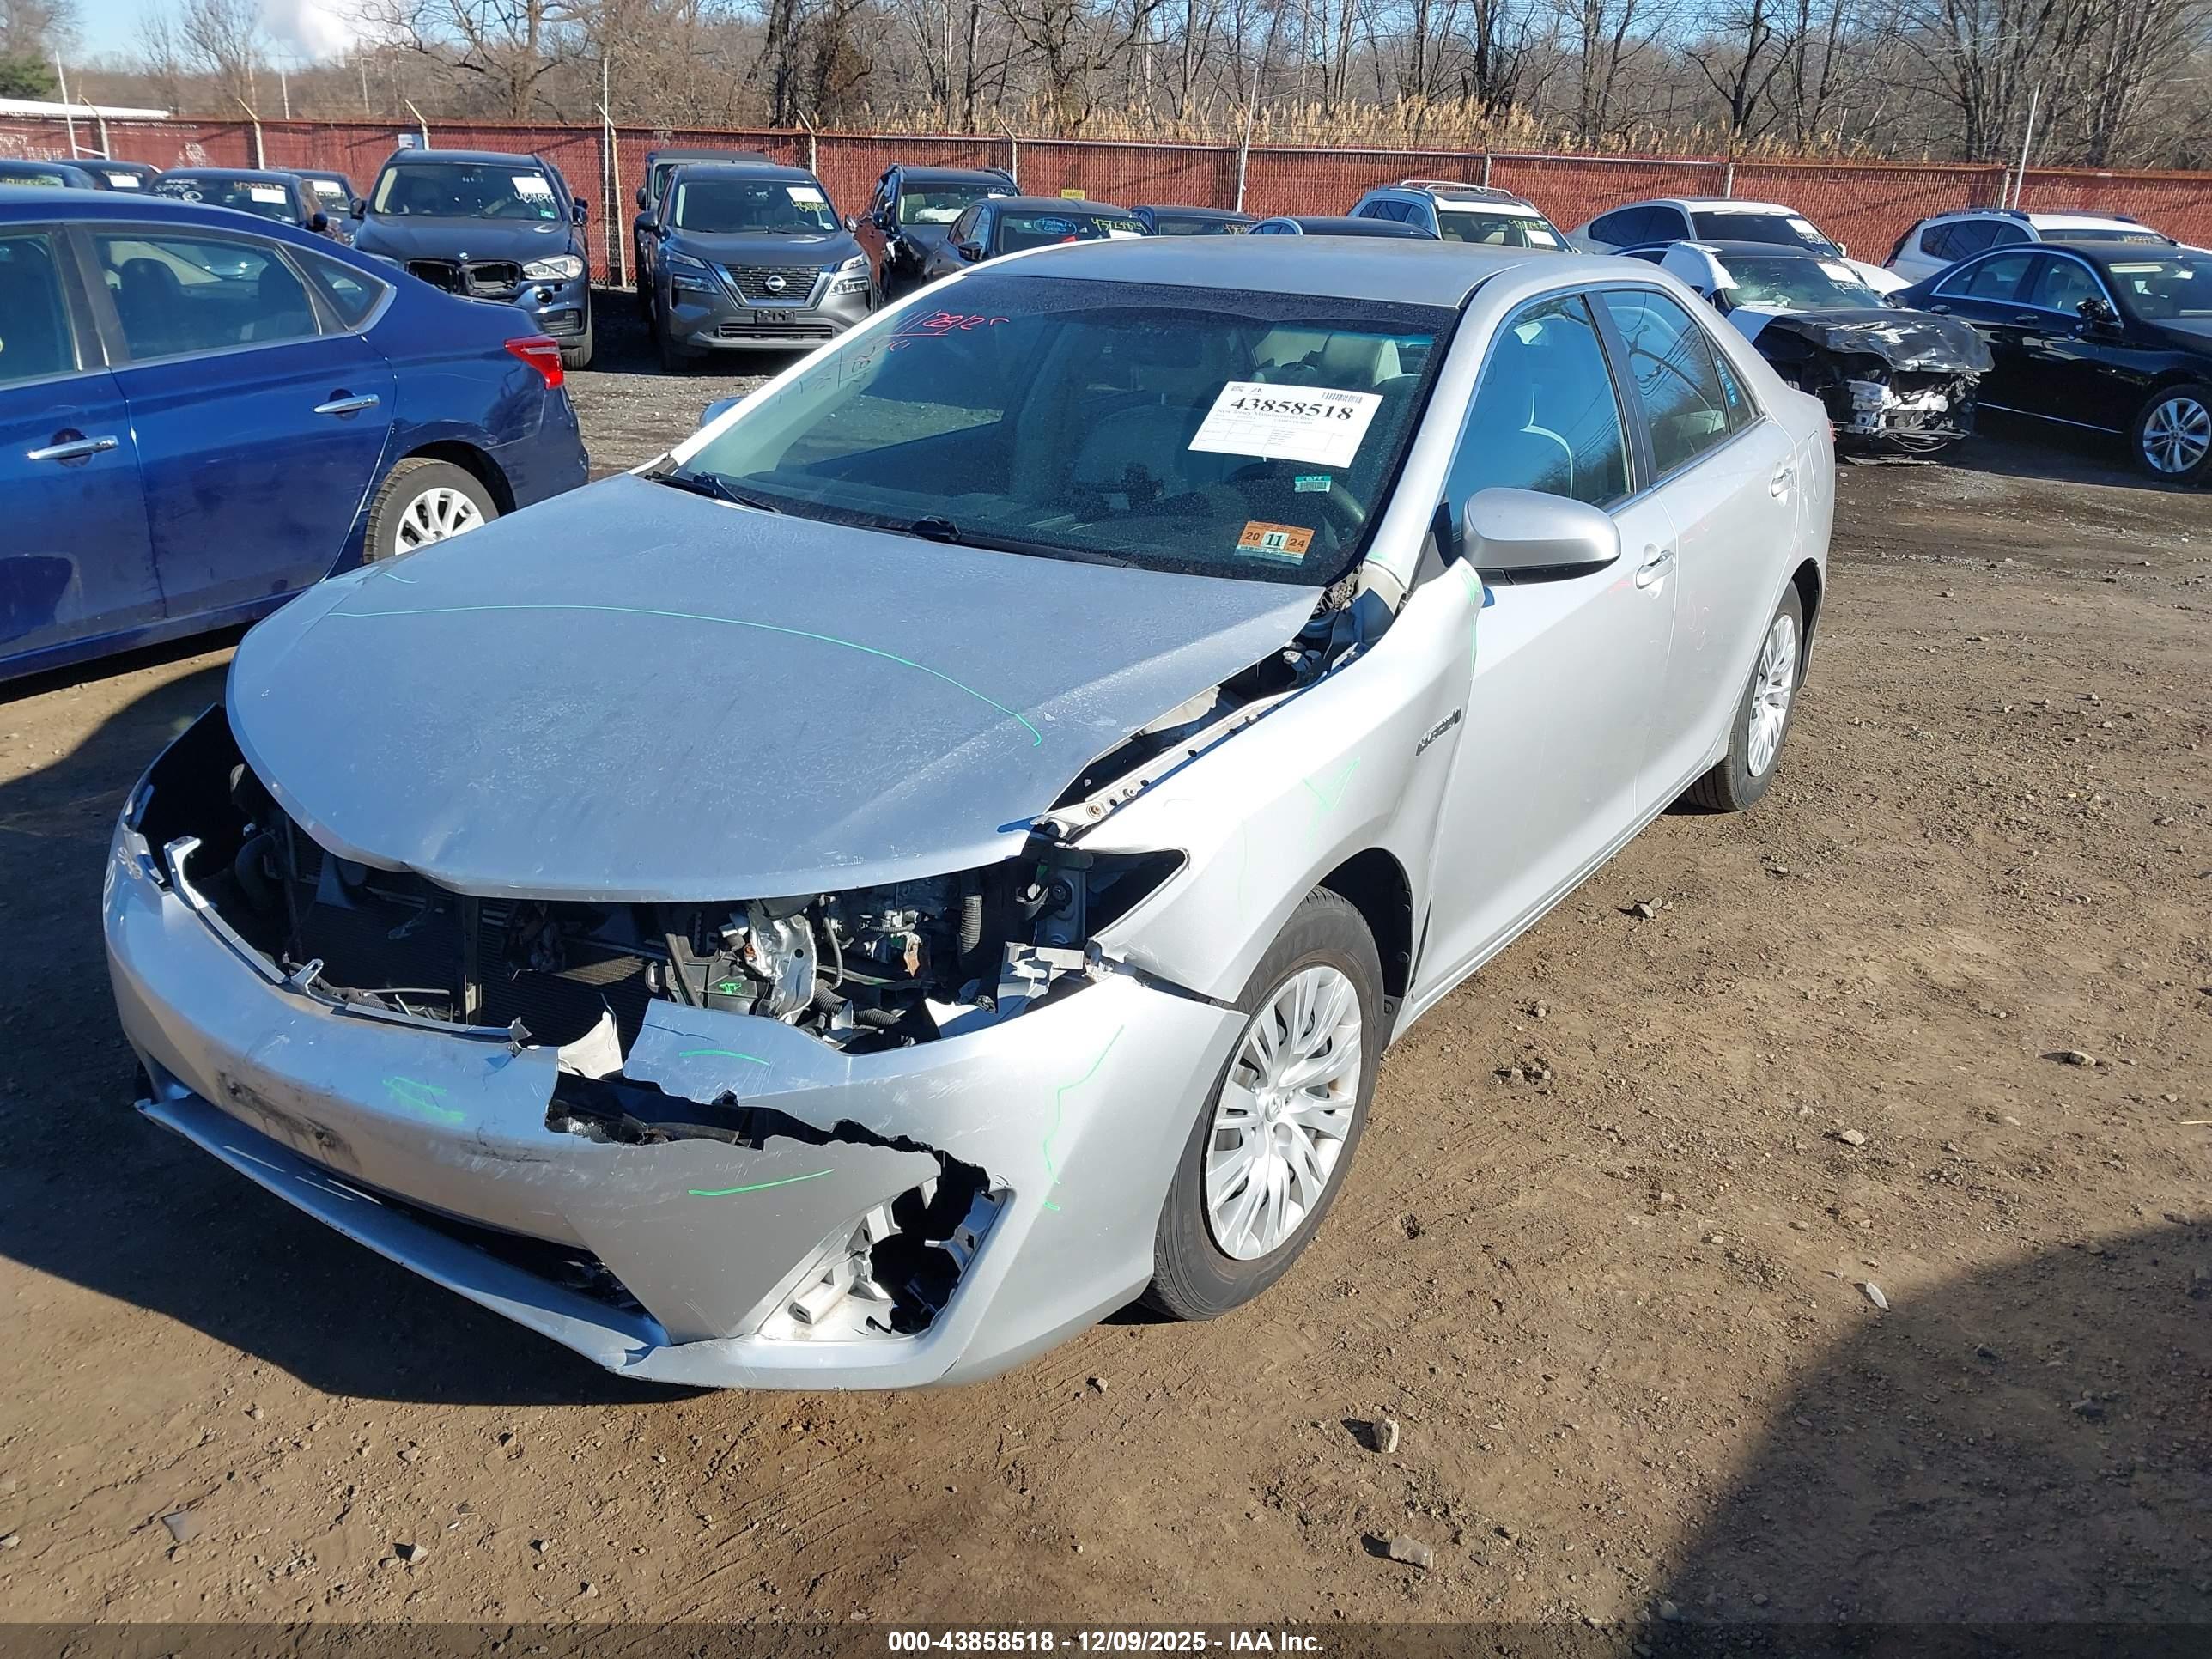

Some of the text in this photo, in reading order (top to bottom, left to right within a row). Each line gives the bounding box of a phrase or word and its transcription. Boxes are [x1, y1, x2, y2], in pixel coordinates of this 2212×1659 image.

[1230, 398, 1354, 420] 43858518
[1245, 532, 1305, 548] 20 11 24
